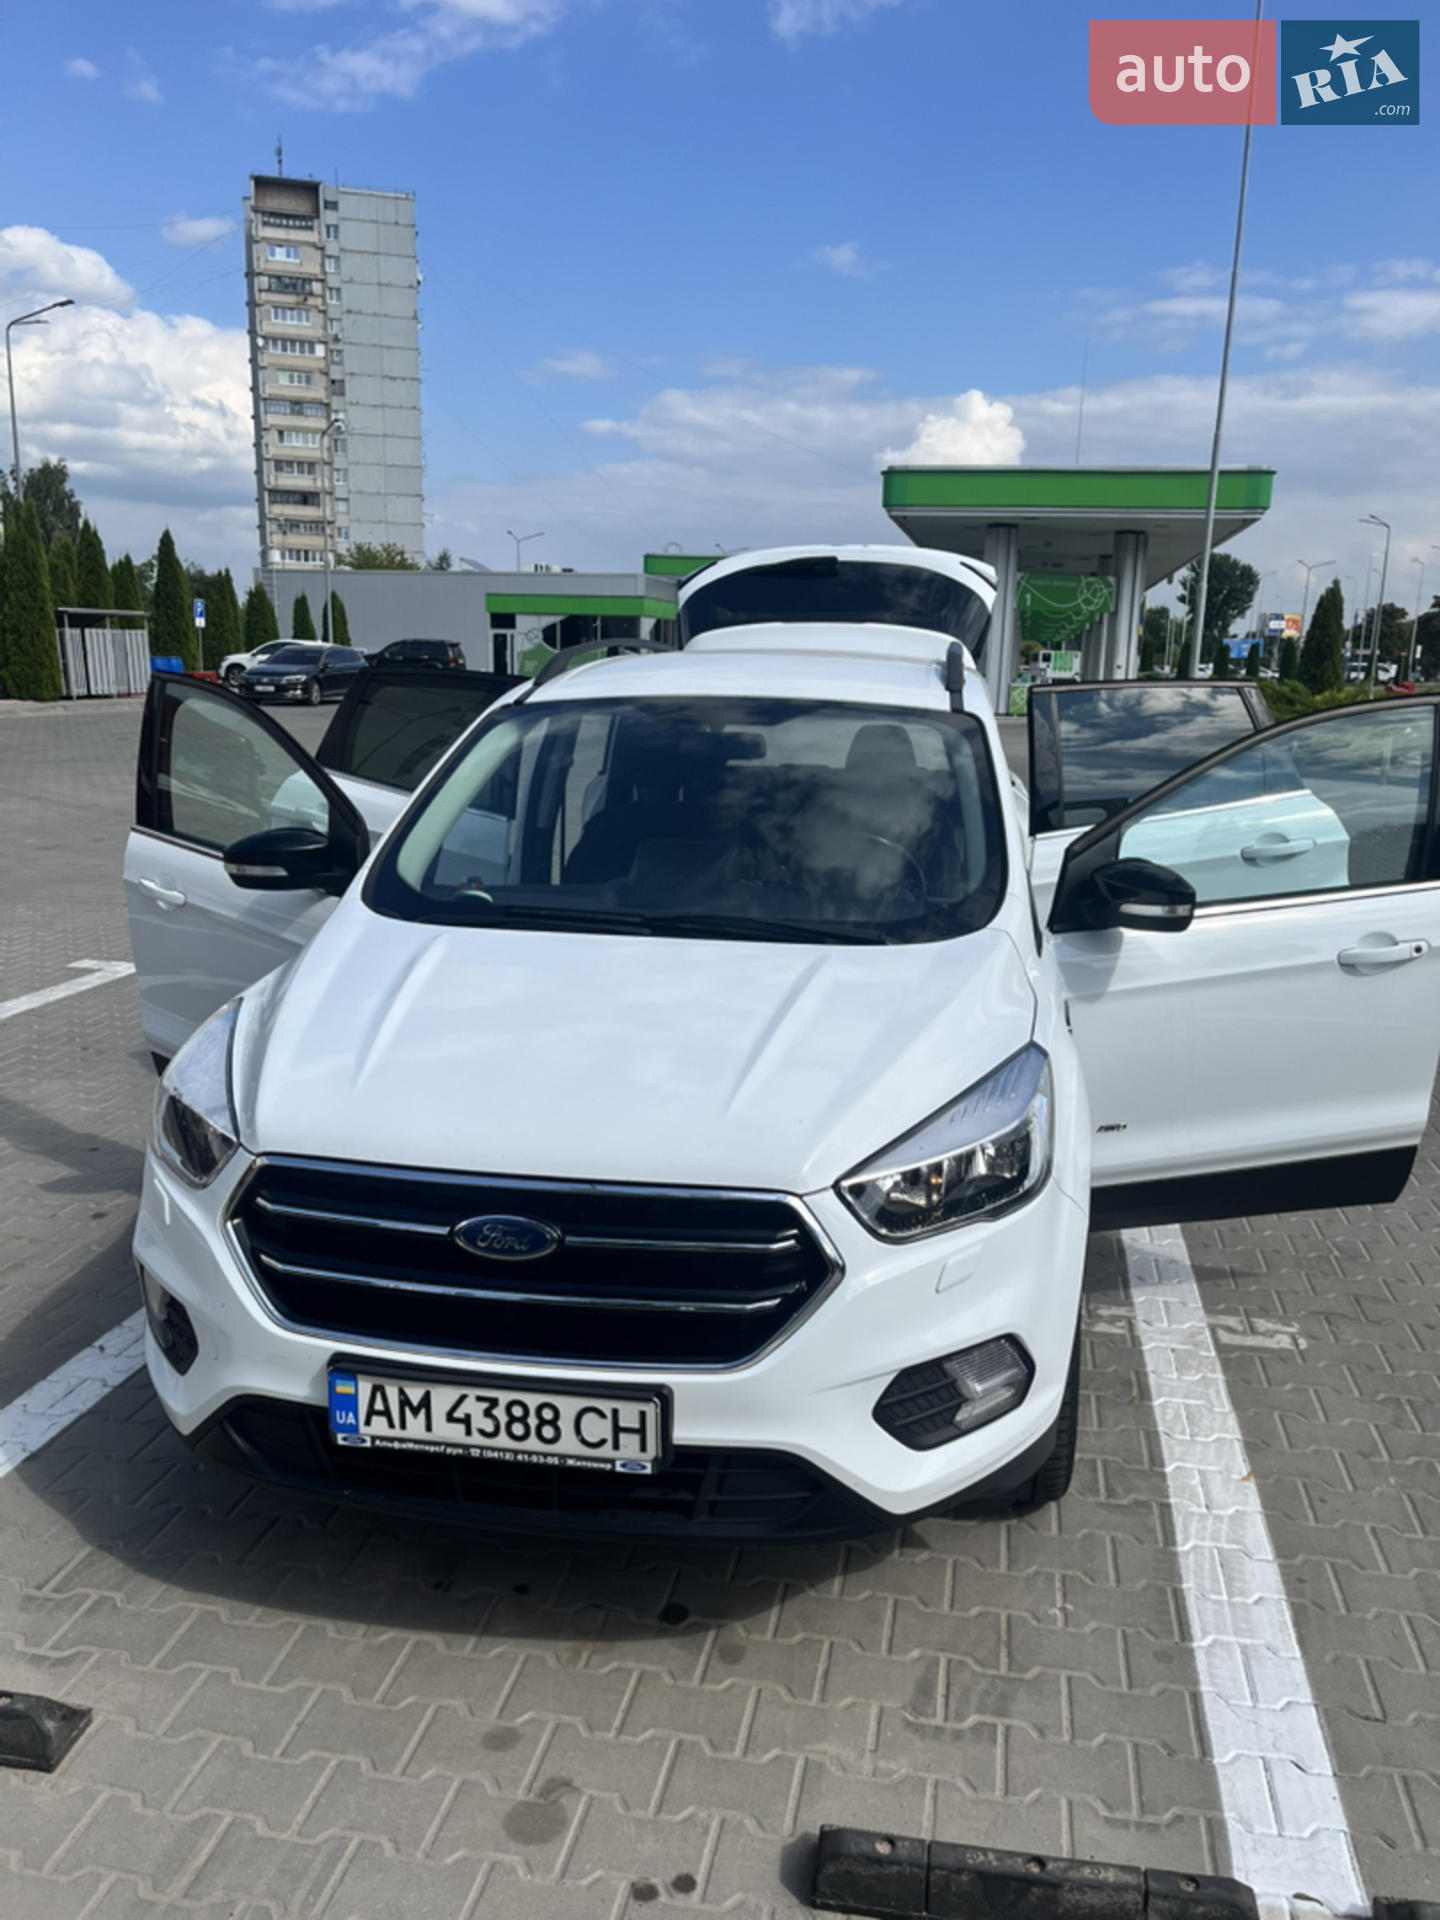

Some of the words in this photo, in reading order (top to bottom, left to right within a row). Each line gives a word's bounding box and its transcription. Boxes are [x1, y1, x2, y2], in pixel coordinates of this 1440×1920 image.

[477, 1223, 534, 1251] Ford
[336, 1410, 357, 1426] UA
[363, 1384, 433, 1433] AM
[445, 1393, 562, 1445] 4388
[574, 1405, 648, 1453] CH
